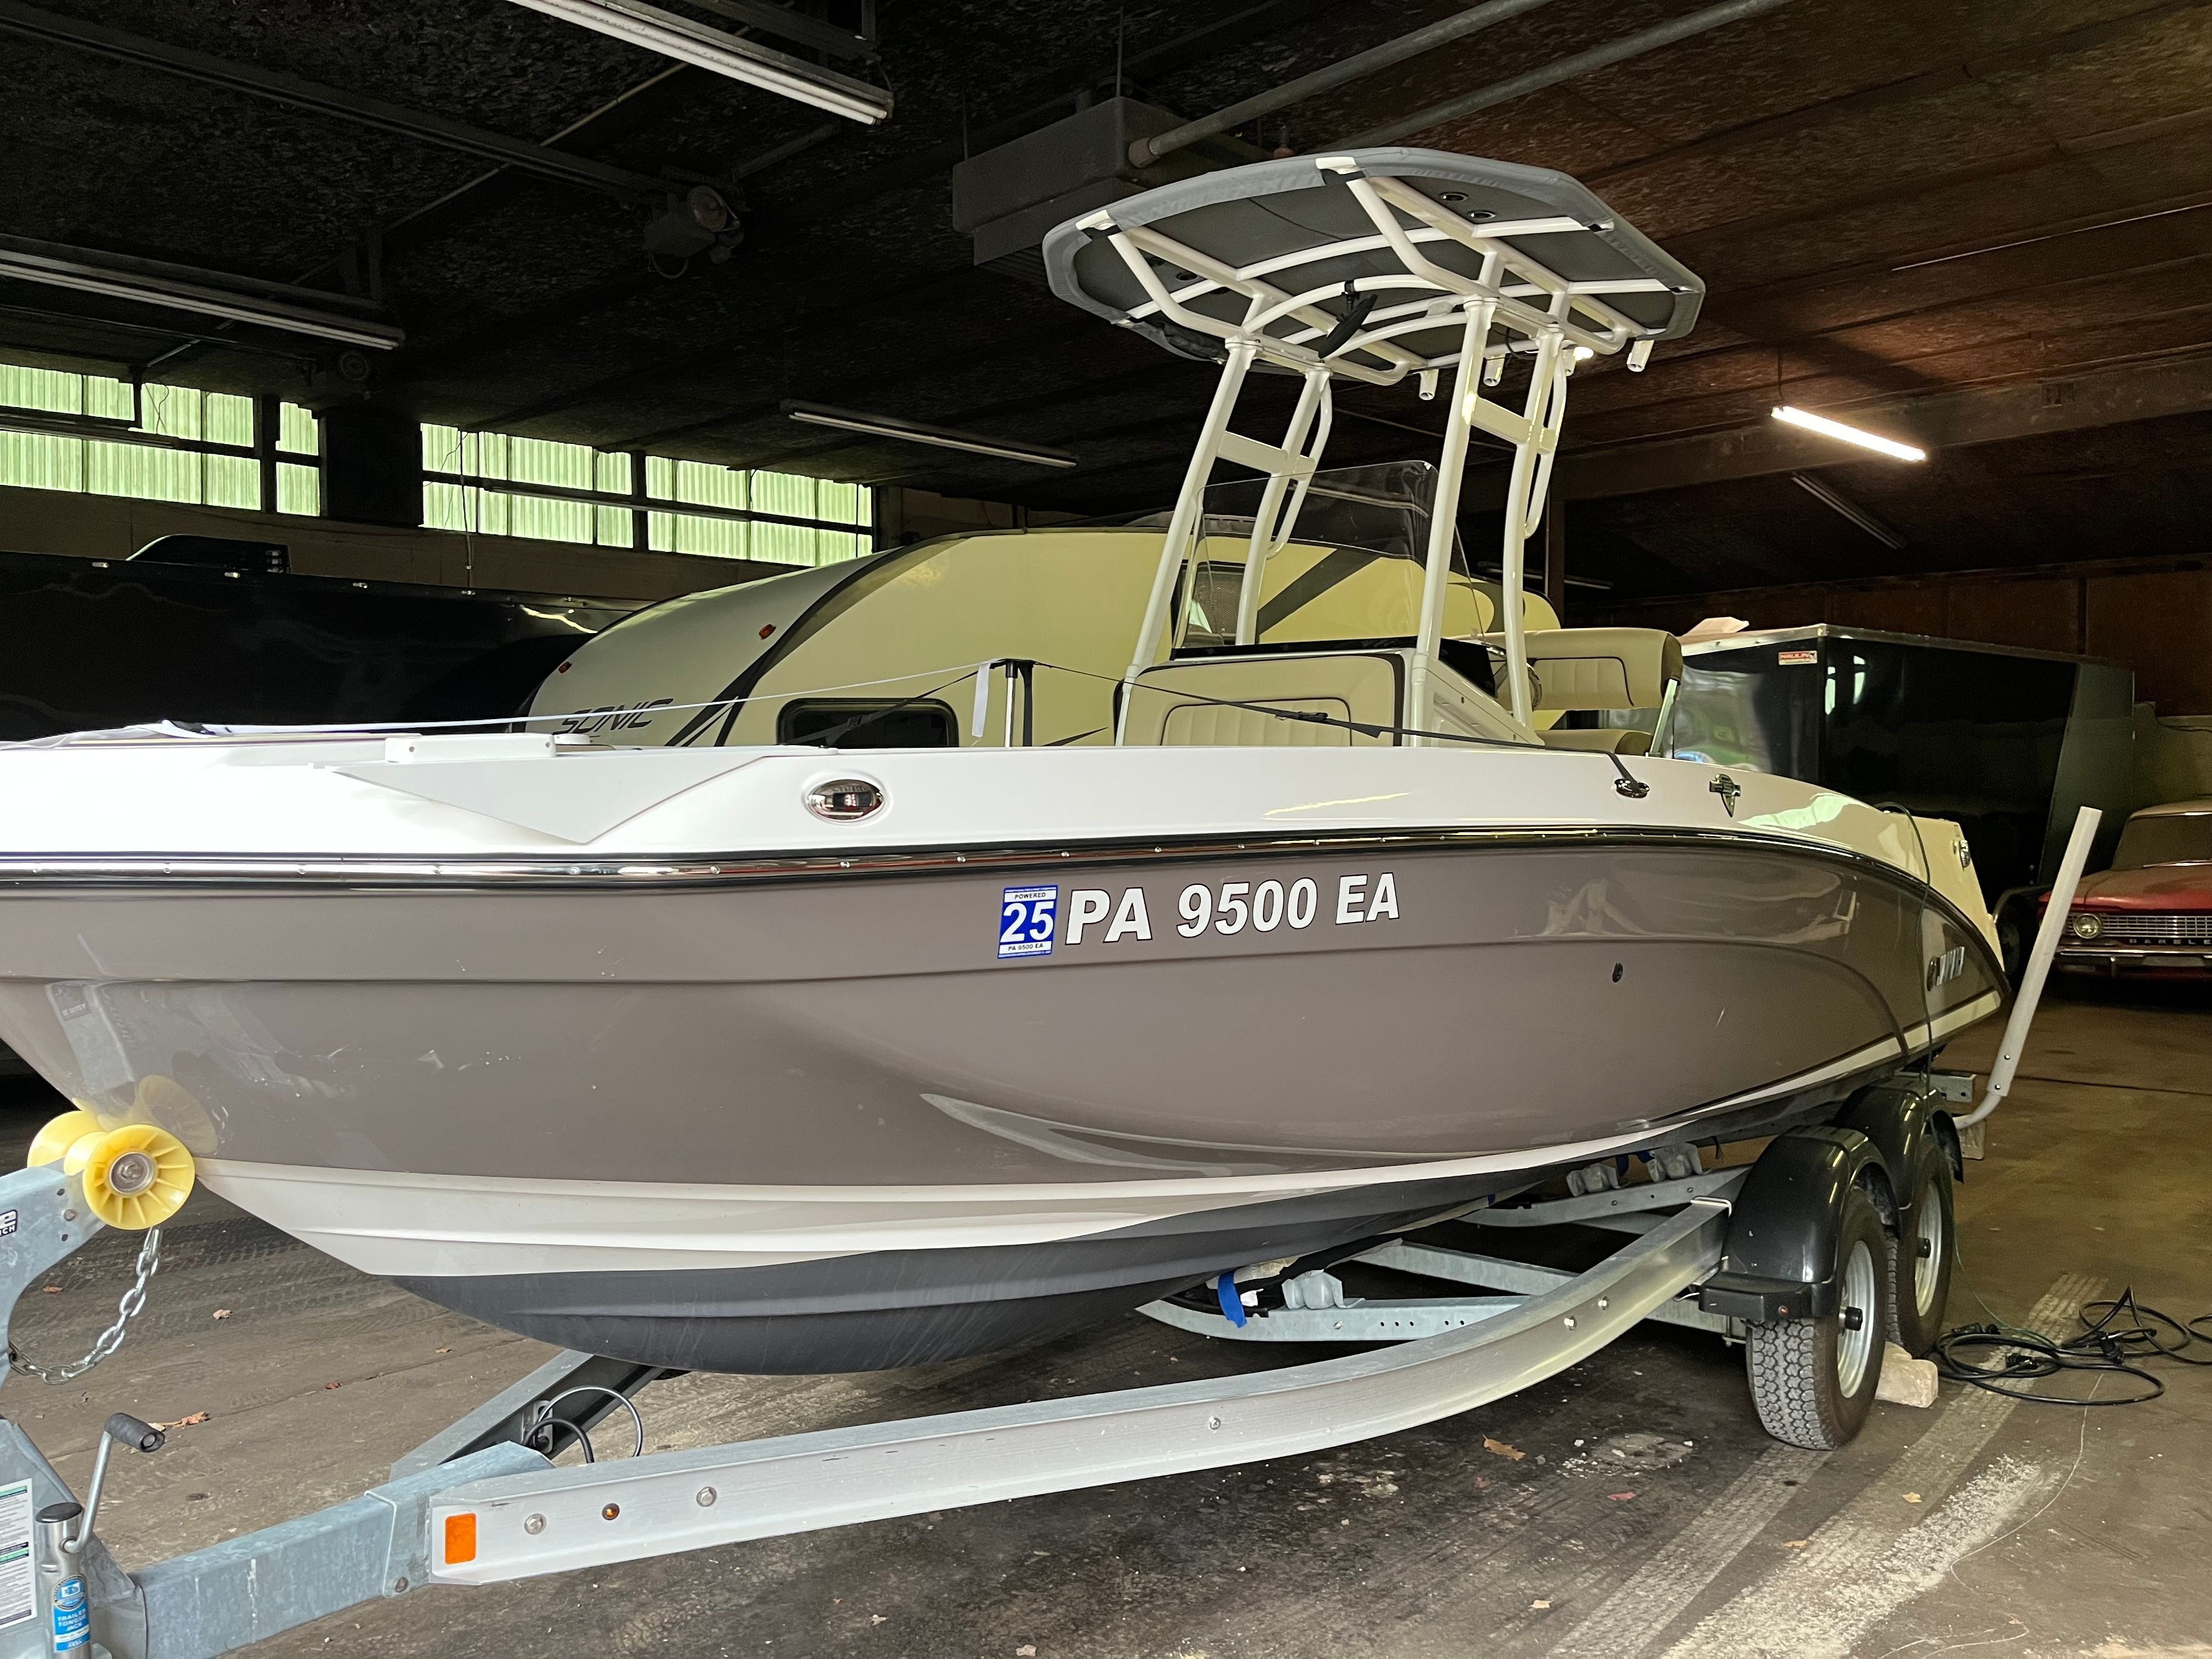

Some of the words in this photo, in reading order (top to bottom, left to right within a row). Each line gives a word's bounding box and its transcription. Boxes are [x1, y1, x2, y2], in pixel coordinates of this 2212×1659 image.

[552, 698, 674, 735] SONIC
[1000, 901, 1054, 943] 25
[1064, 887, 1153, 946] PA
[1176, 877, 1318, 938] 9500
[1334, 871, 1400, 926] EA
